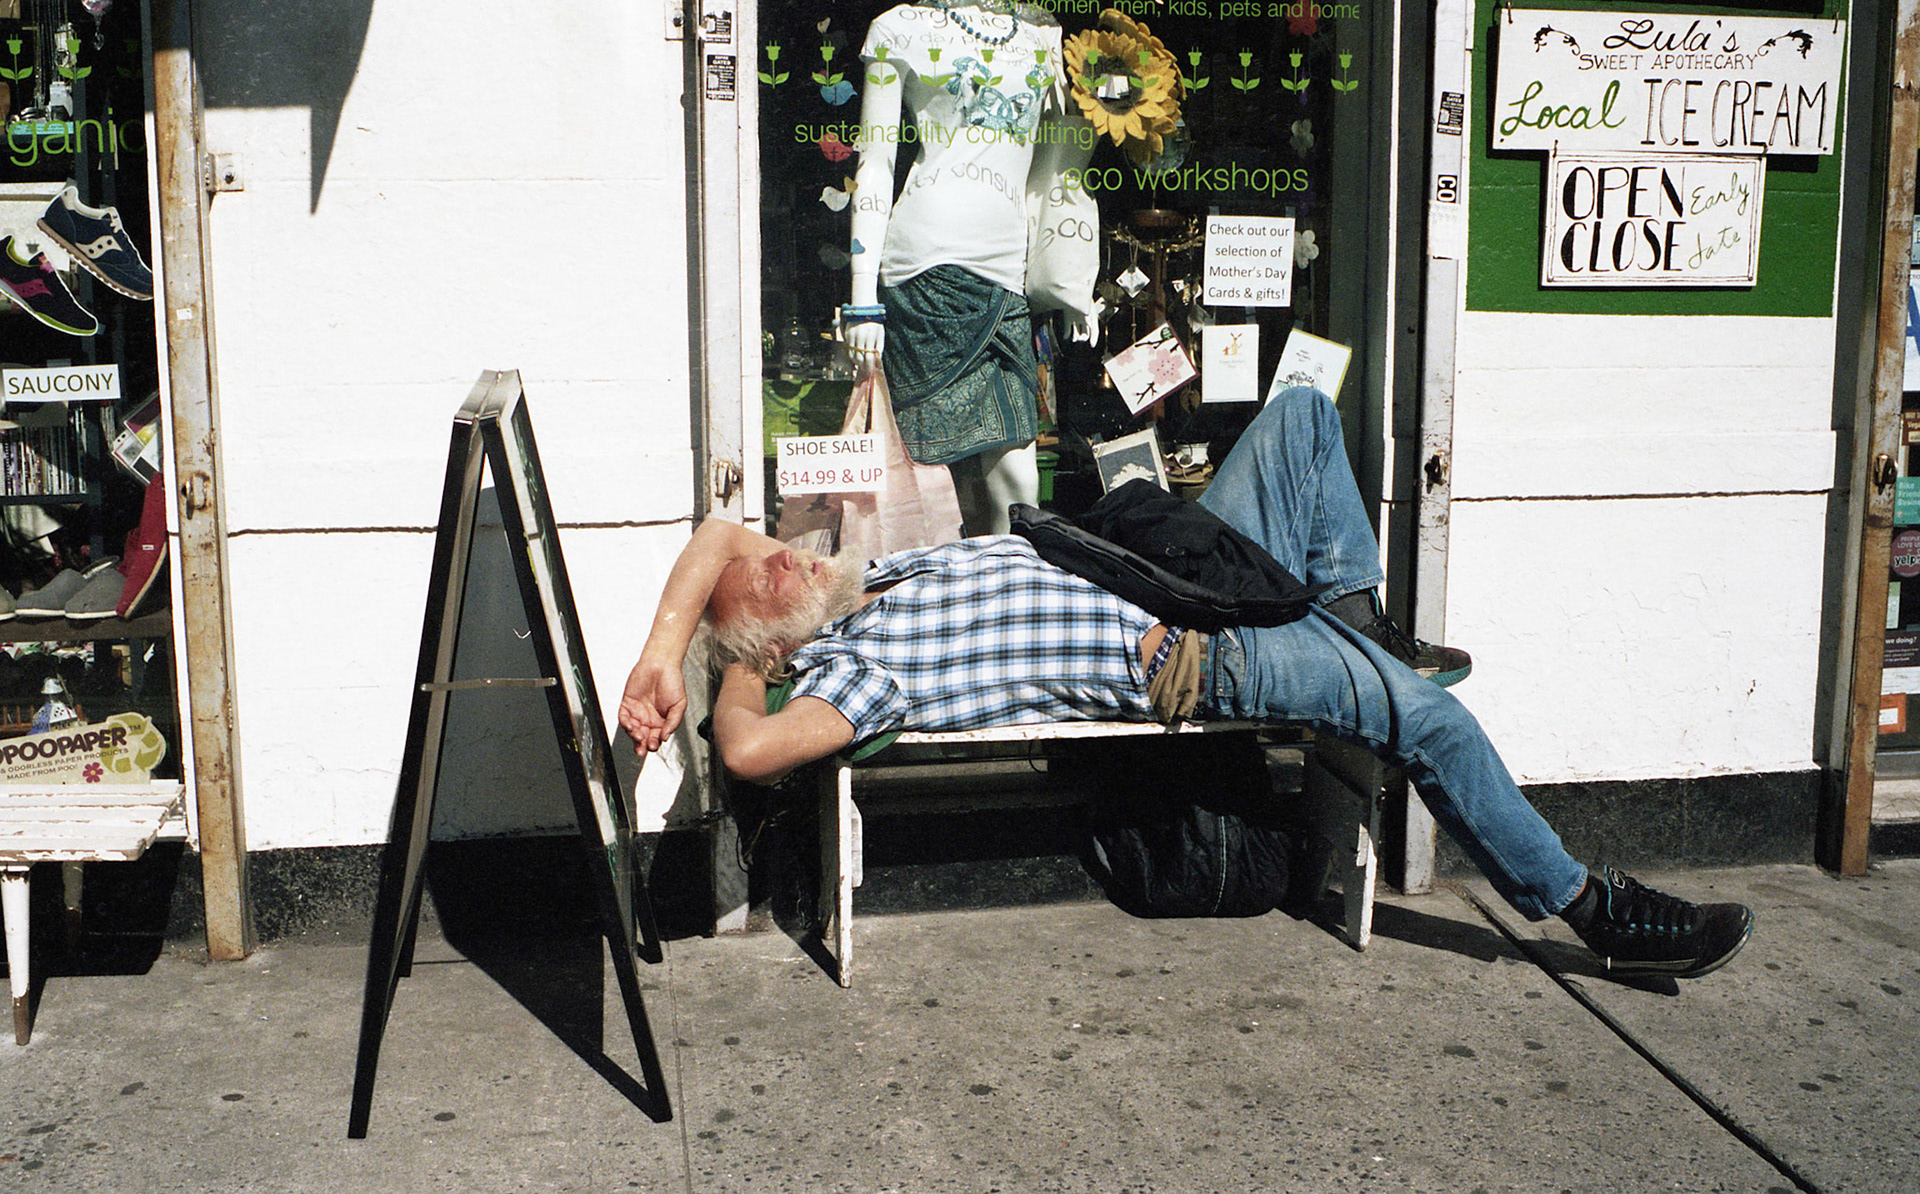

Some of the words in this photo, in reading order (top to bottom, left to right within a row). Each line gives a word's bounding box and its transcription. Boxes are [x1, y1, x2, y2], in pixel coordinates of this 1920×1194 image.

[1112, 0, 1162, 17] men,
[1168, 0, 1213, 18] kids,
[1220, 0, 1262, 20] pets
[1267, 2, 1304, 19] and
[1602, 18, 1740, 53] Lula's
[1578, 54, 1643, 71] SWEET
[1651, 54, 1758, 70] APOTHECARY
[1500, 79, 1628, 137] Local
[1640, 78, 1704, 146] ICE
[0, 107, 146, 167] ganic
[794, 119, 959, 149] sustainability
[965, 119, 1094, 150] consulting
[1063, 168, 1123, 192] eco
[1134, 161, 1310, 198] workshops
[1562, 166, 1686, 221] OPEN
[1689, 172, 1750, 217] Early
[1209, 223, 1244, 236] Check
[1246, 226, 1267, 237] out
[1269, 227, 1290, 237] our
[1215, 244, 1267, 257] selection
[1269, 246, 1283, 258] of
[1560, 218, 1687, 274] CLOSE
[1208, 265, 1262, 278] Mother's
[1264, 266, 1287, 280] Day
[1208, 286, 1241, 298] Cards
[1243, 286, 1253, 299] &
[1255, 287, 1286, 301] gifts!
[8, 372, 114, 395] SAUCONY
[786, 441, 828, 456] SHOE
[832, 438, 874, 454] SALE!
[779, 470, 837, 488] $14.99
[841, 468, 855, 484] &
[860, 467, 883, 482] UP
[0, 727, 127, 765] POOPAPER
[7, 761, 54, 772] ODORLESS
[54, 755, 83, 765] PAPER
[84, 747, 129, 760] PRODUCTS
[6, 772, 31, 781] MADE
[32, 766, 57, 776] FROM
